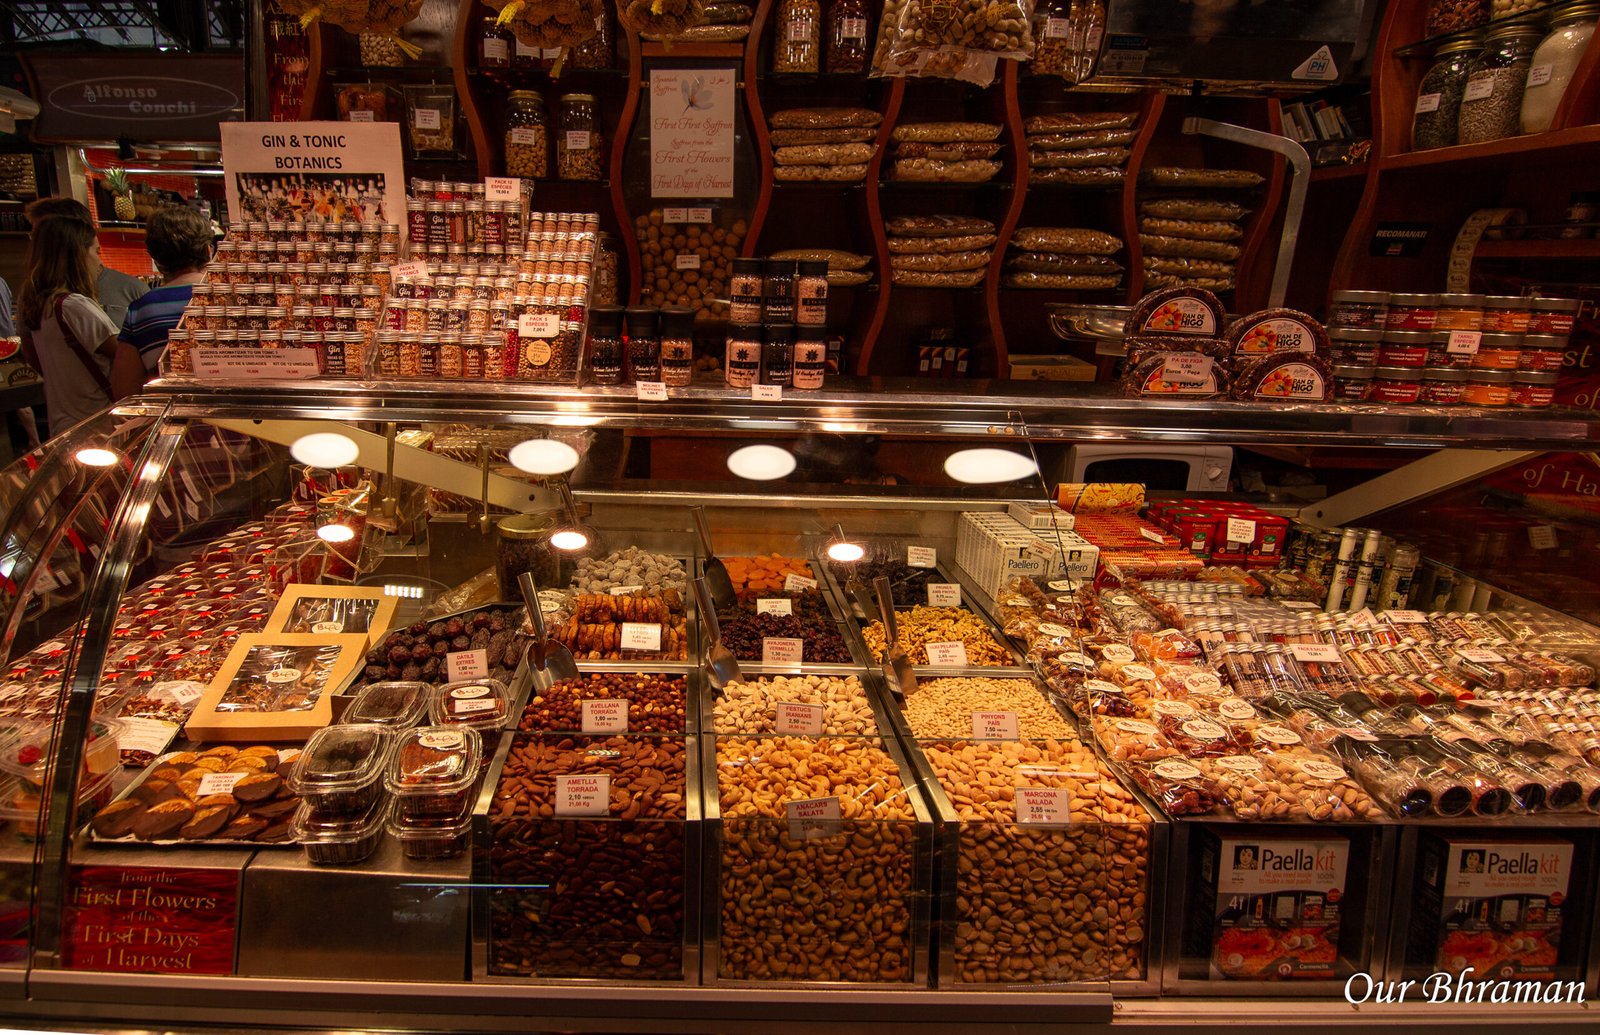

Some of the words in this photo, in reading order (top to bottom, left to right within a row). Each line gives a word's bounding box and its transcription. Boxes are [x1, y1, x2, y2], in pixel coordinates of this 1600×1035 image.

[1311, 61, 1326, 71] PH
[82, 85, 157, 98] Alfonso
[128, 101, 196, 114] Conchi
[654, 118, 677, 129] First
[678, 118, 701, 129] First
[703, 118, 733, 136] Saffron
[261, 135, 287, 148] GIN
[290, 135, 301, 148] &
[302, 135, 346, 148] TONIC
[655, 151, 685, 164] First
[686, 151, 731, 164] Flowers
[275, 156, 342, 170] BOTANICS
[653, 175, 673, 188] First
[674, 175, 694, 193] Days
[399, 288, 410, 297] Gin
[438, 290, 449, 299] Gin
[477, 290, 487, 299] Gin
[429, 312, 440, 320] Gin
[251, 320, 263, 329] Gin
[336, 321, 347, 330] Gin
[1181, 319, 1203, 327] HIGO
[328, 345, 341, 354] Gin
[382, 349, 394, 359] Gin
[467, 349, 478, 358] Gin
[1291, 384, 1313, 392] HIGO
[1523, 463, 1555, 488] of
[1008, 559, 1039, 570] Paellero
[796, 801, 828, 810] ANACARS
[798, 809, 824, 817] SALATS
[121, 872, 151, 885] from
[156, 872, 177, 884] the
[73, 886, 122, 906] First
[131, 886, 217, 910] Flowers
[122, 910, 134, 922] of
[84, 925, 135, 944] First
[143, 927, 200, 953] Days
[106, 947, 192, 969] Harvest
